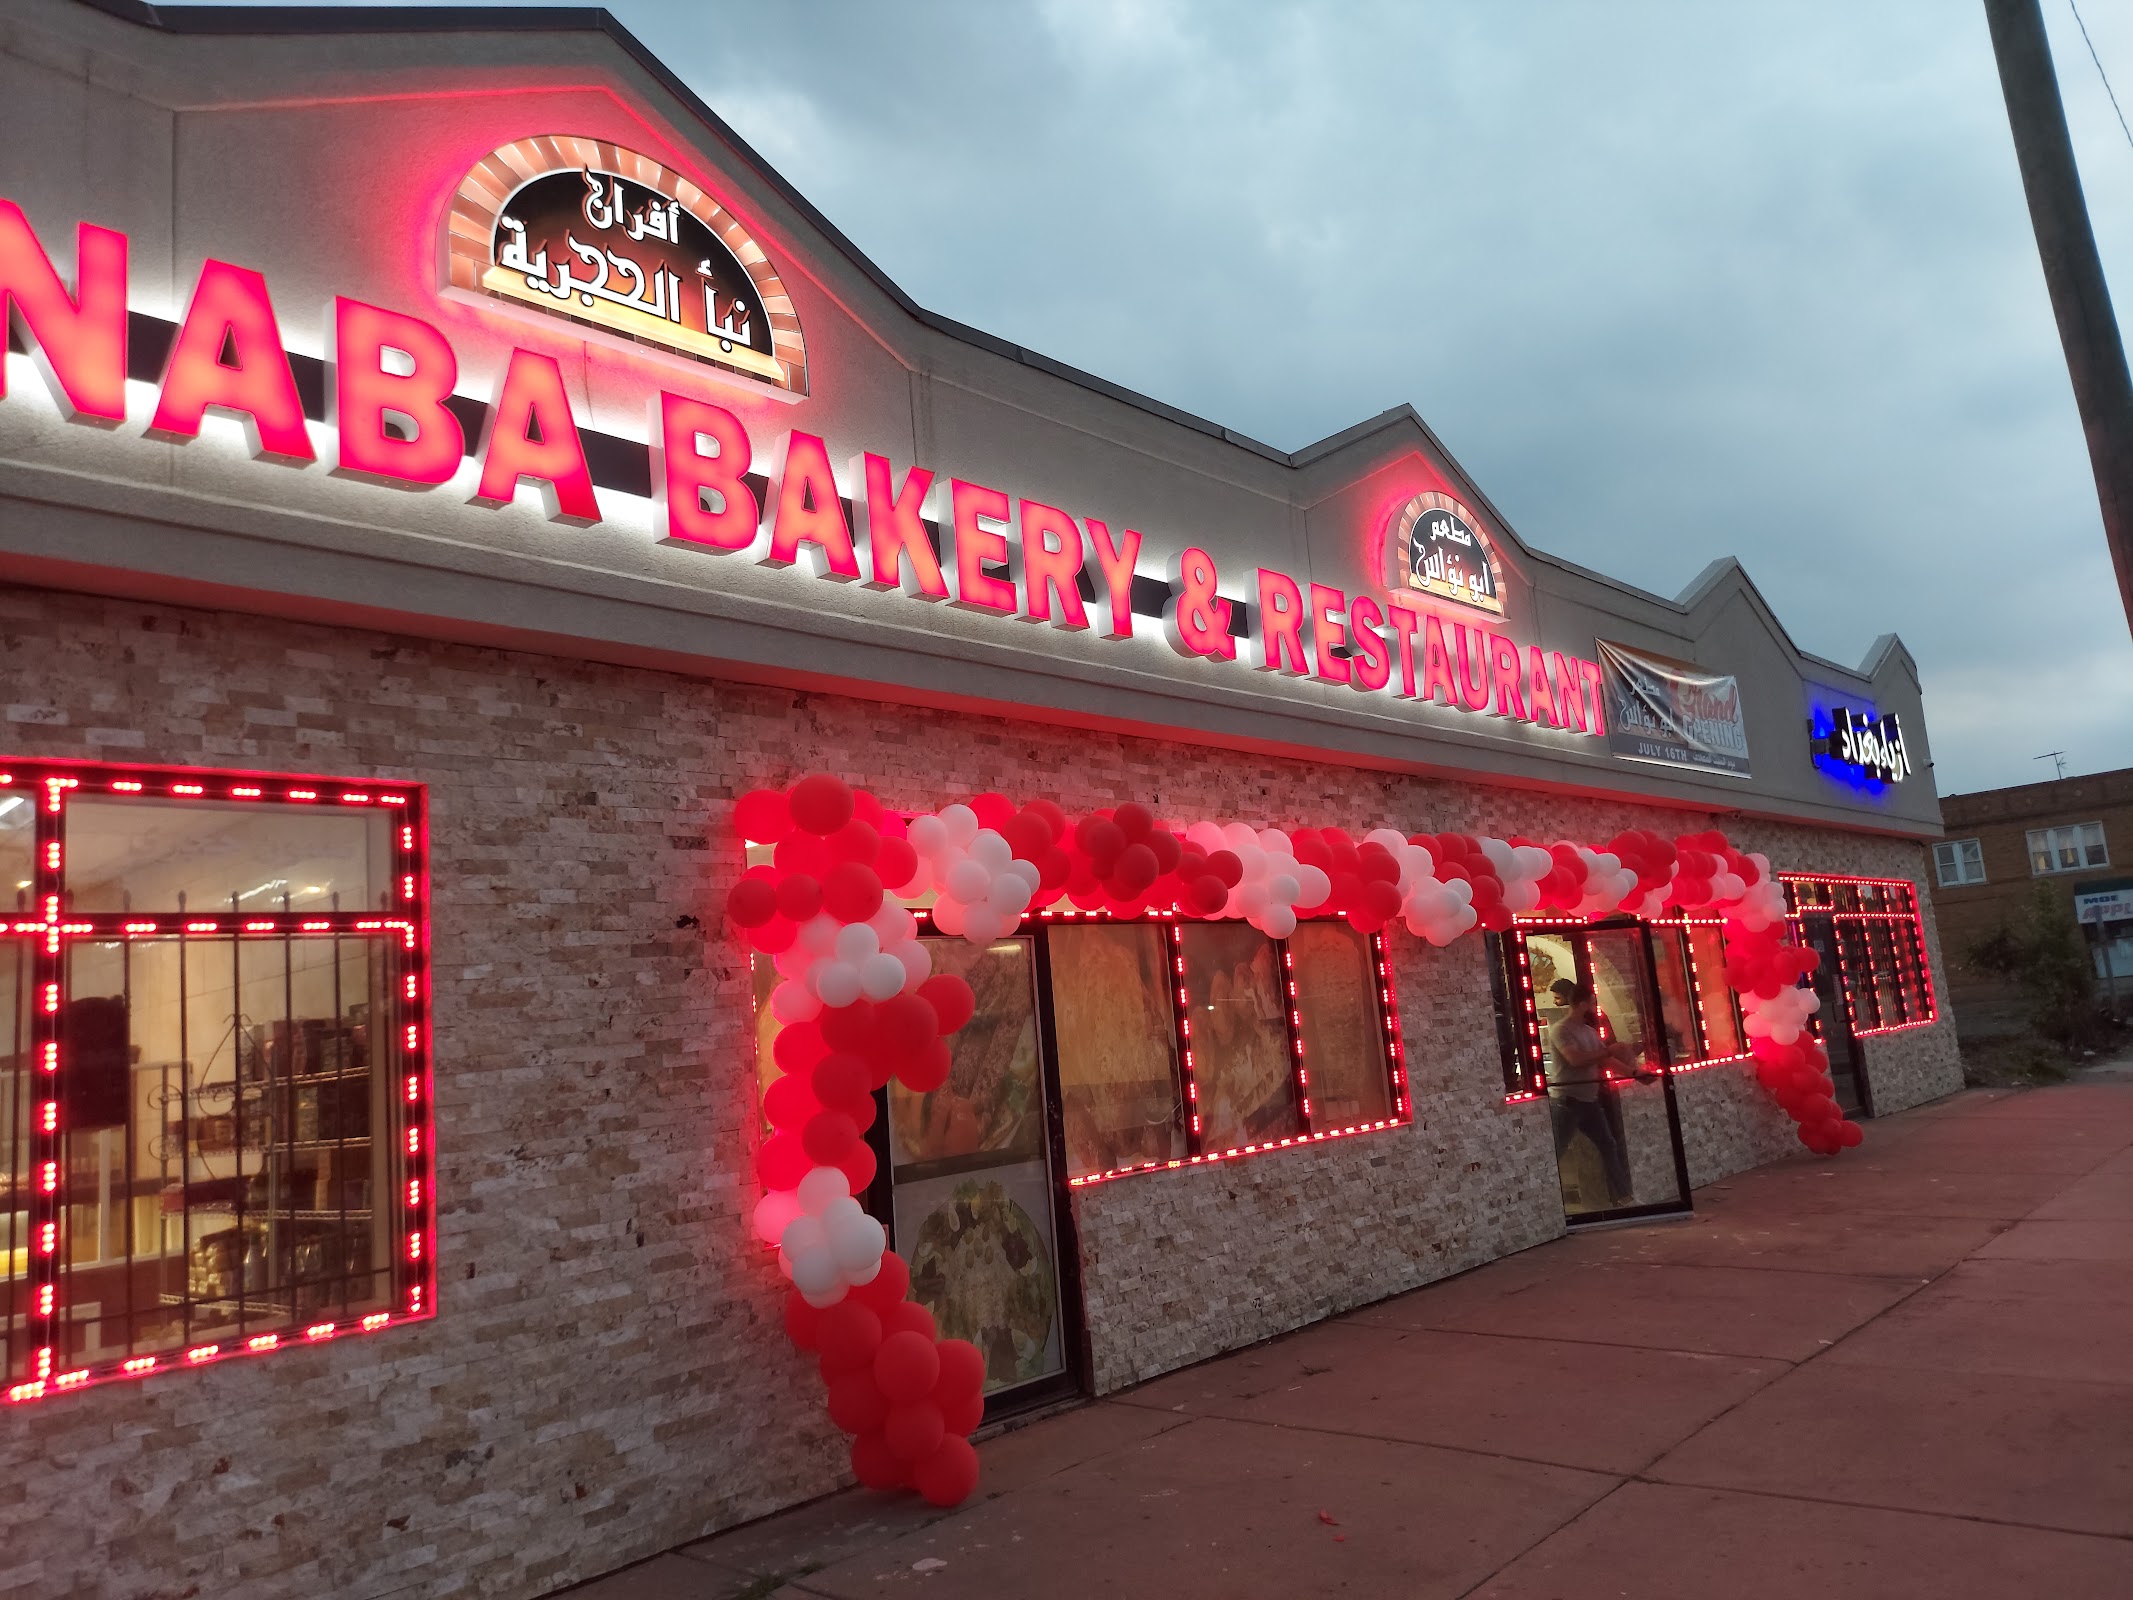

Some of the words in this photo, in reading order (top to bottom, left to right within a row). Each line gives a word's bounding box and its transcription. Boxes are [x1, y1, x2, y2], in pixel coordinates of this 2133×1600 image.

[584, 166, 681, 244] أفران
[501, 216, 681, 323] الحجرية
[696, 257, 751, 353] نبأ
[0, 196, 603, 523] NABA
[664, 390, 1143, 638] BAKERY
[1174, 546, 1237, 660] &
[1256, 567, 1605, 736] RESTAURANT
[1430, 515, 1472, 547] مطعم
[1638, 742, 1661, 757] JULY
[1664, 746, 1687, 762] 16TH
